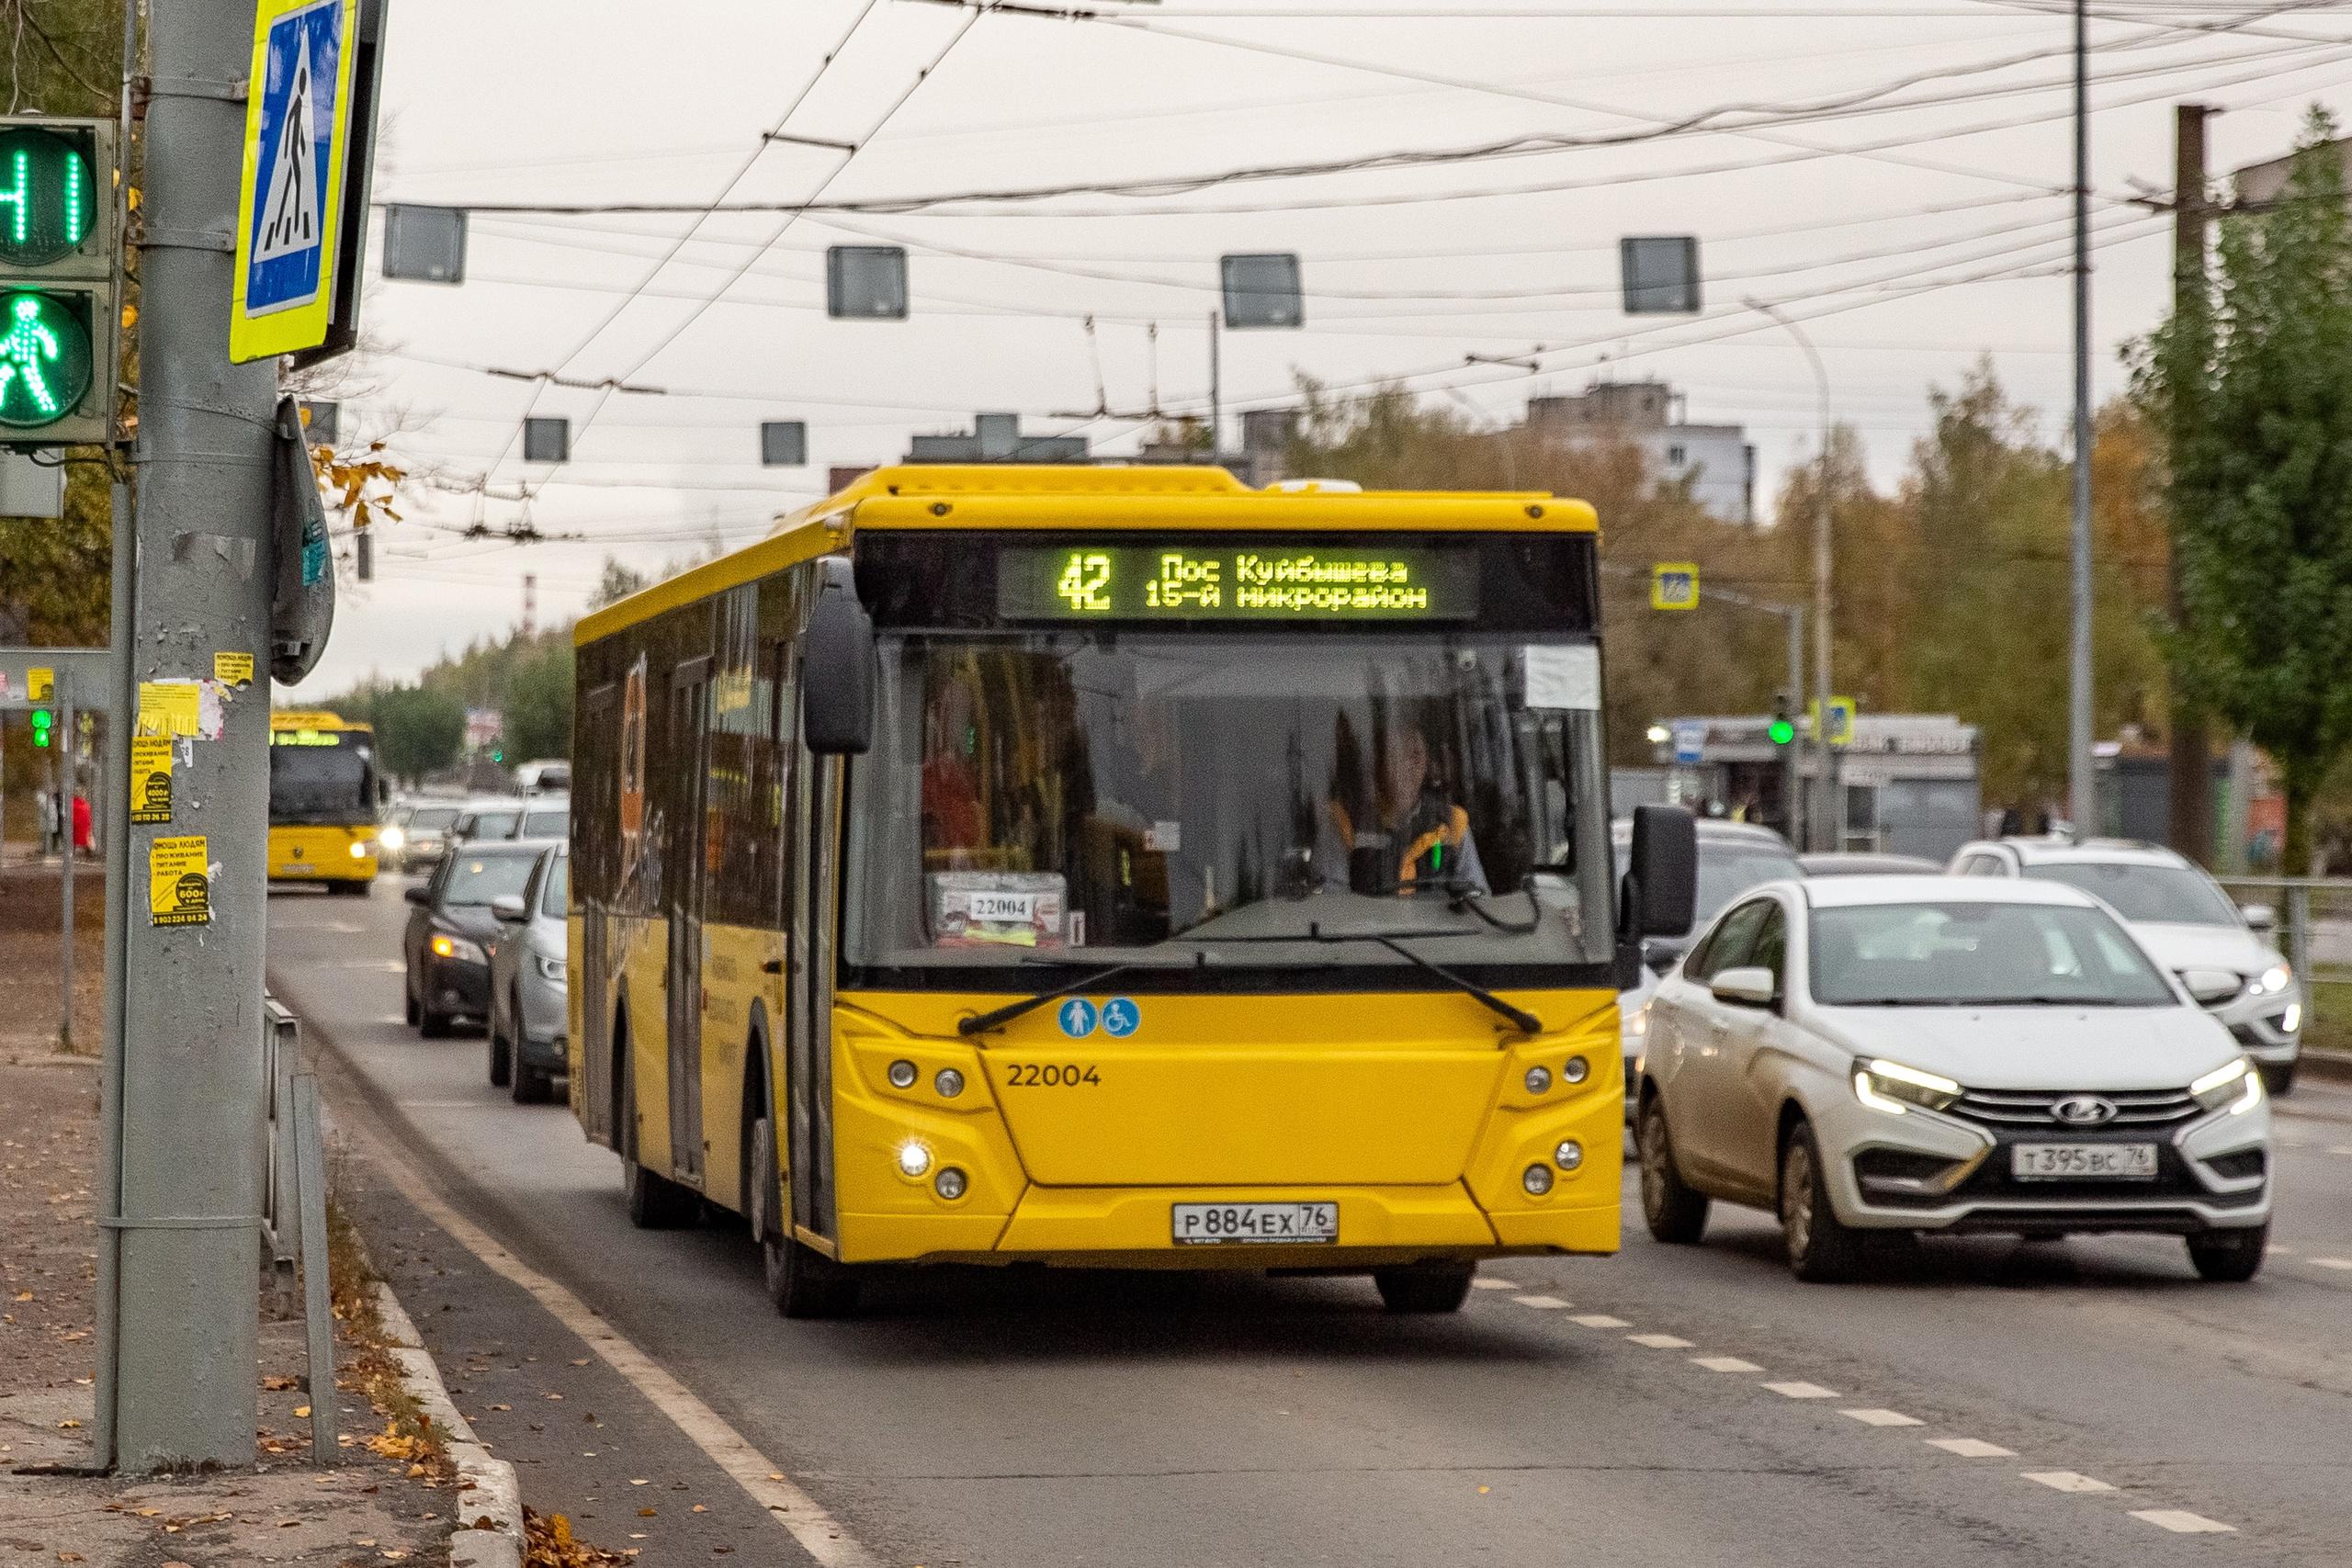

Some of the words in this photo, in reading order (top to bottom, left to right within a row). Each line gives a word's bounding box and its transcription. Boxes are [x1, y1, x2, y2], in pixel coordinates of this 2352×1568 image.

[1058, 554, 1110, 609] 42
[1161, 554, 1219, 581] Пос
[1237, 555, 1408, 585] Куйбышева
[1147, 580, 1220, 606] 15-й
[1237, 584, 1426, 611] микрорайон
[155, 851, 203, 859] ПРОЖИВАНИЕ
[977, 900, 1025, 915] 22004
[1007, 1064, 1102, 1087] 22004
[1302, 1206, 1328, 1227] 76
